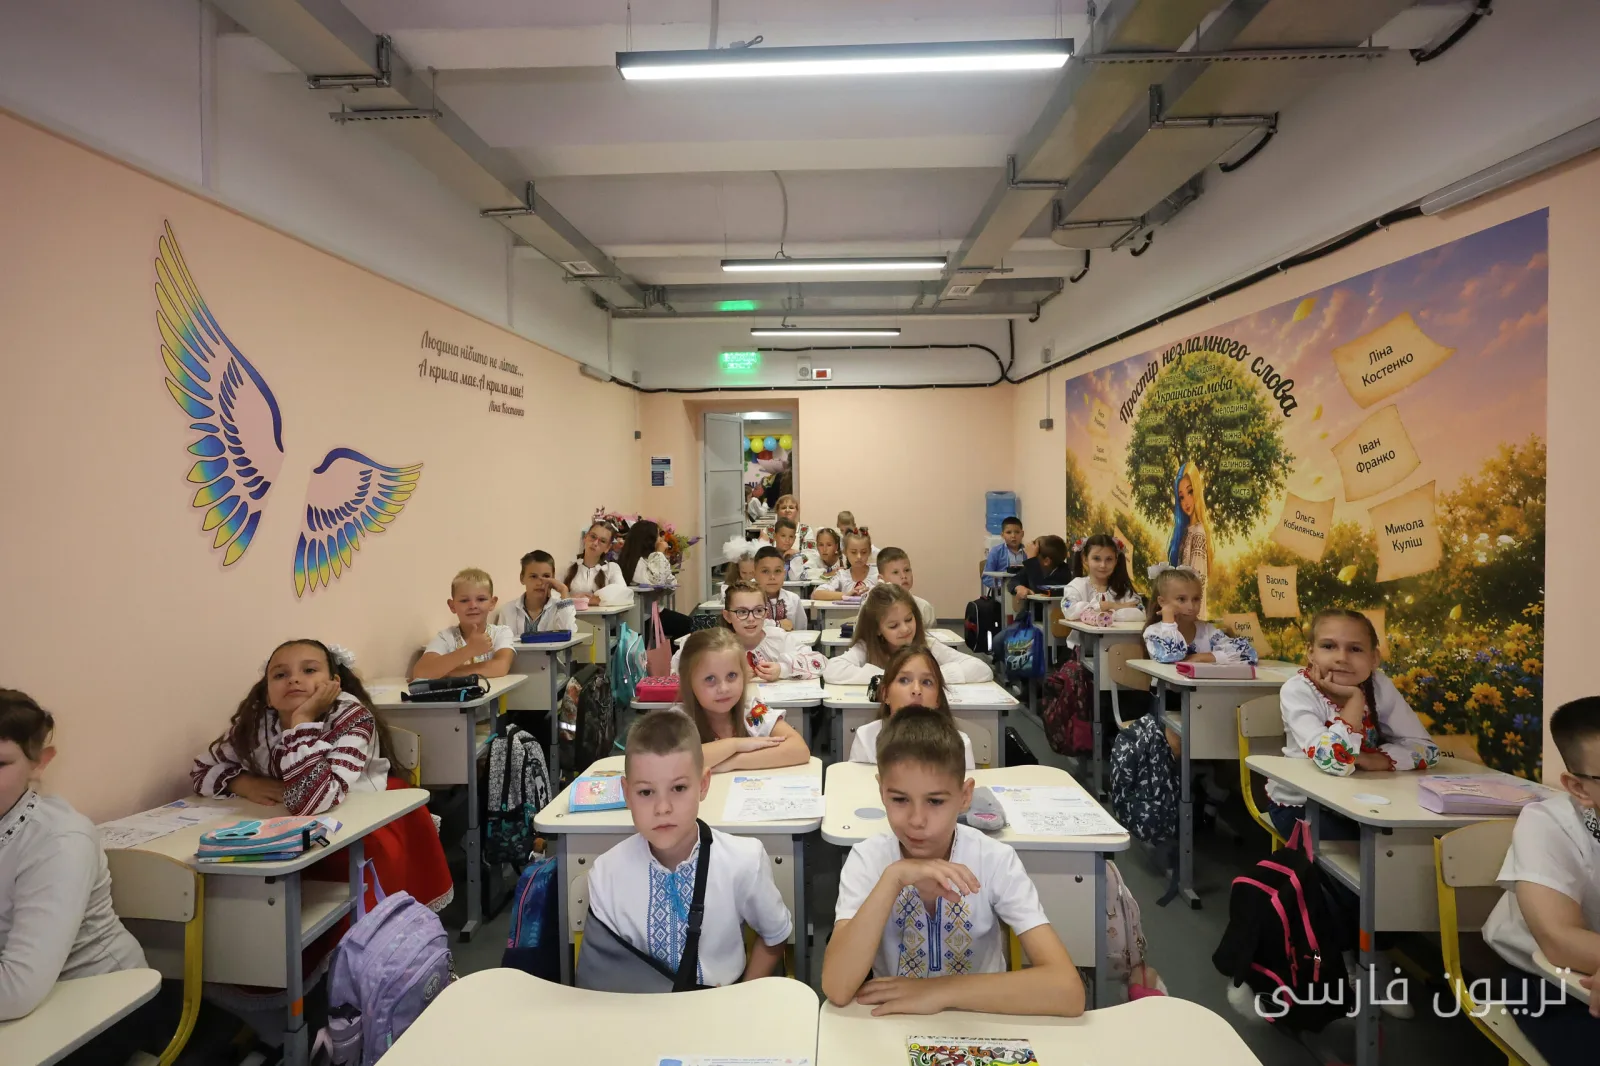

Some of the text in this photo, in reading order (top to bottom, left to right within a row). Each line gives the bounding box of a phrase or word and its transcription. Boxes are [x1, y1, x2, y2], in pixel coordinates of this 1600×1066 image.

[421, 330, 459, 357] Людина
[460, 345, 488, 366] нібито
[489, 356, 497, 369] не
[1368, 345, 1394, 365] Ліна
[418, 358, 428, 377] А
[429, 365, 458, 383] крила
[486, 379, 508, 396] крила
[509, 385, 524, 398] має!
[1119, 335, 1298, 424] Простір незламного слова
[1361, 352, 1414, 387] Костенко
[1154, 385, 1204, 403] Українська
[1204, 375, 1233, 394] мова
[1358, 437, 1381, 455] Іван
[1355, 450, 1396, 473] Франко
[1295, 510, 1316, 525] Ольга
[1384, 518, 1425, 536] Микола
[1283, 519, 1325, 540] Кобилянська
[1392, 536, 1423, 554] Куліш
[1265, 574, 1289, 586] Василь
[1270, 588, 1286, 600] Стус
